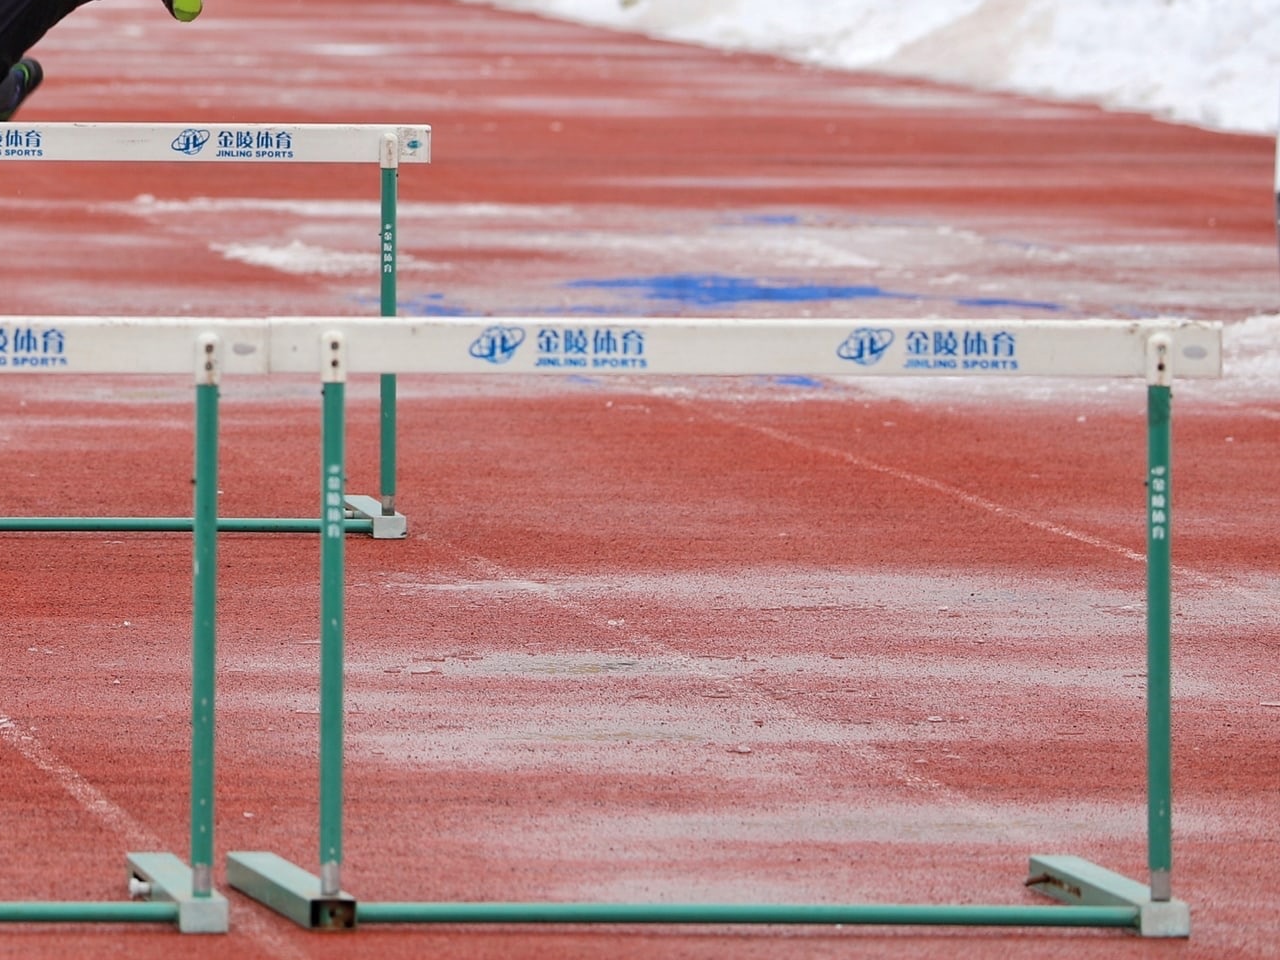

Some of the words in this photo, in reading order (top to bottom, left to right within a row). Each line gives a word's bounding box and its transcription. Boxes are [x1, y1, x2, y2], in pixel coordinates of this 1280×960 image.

[218, 131, 293, 149] 金陵体育
[5, 149, 43, 157] SPORTS
[255, 150, 294, 158] SPORTS
[537, 329, 645, 355] 金陵体育
[905, 330, 1016, 356] 金陵体育
[12, 356, 68, 366] SPORTS
[535, 357, 588, 367] JINLING
[592, 358, 648, 368] SPORTS
[903, 359, 958, 369] JINLING
[962, 359, 1019, 370] SPORTS
